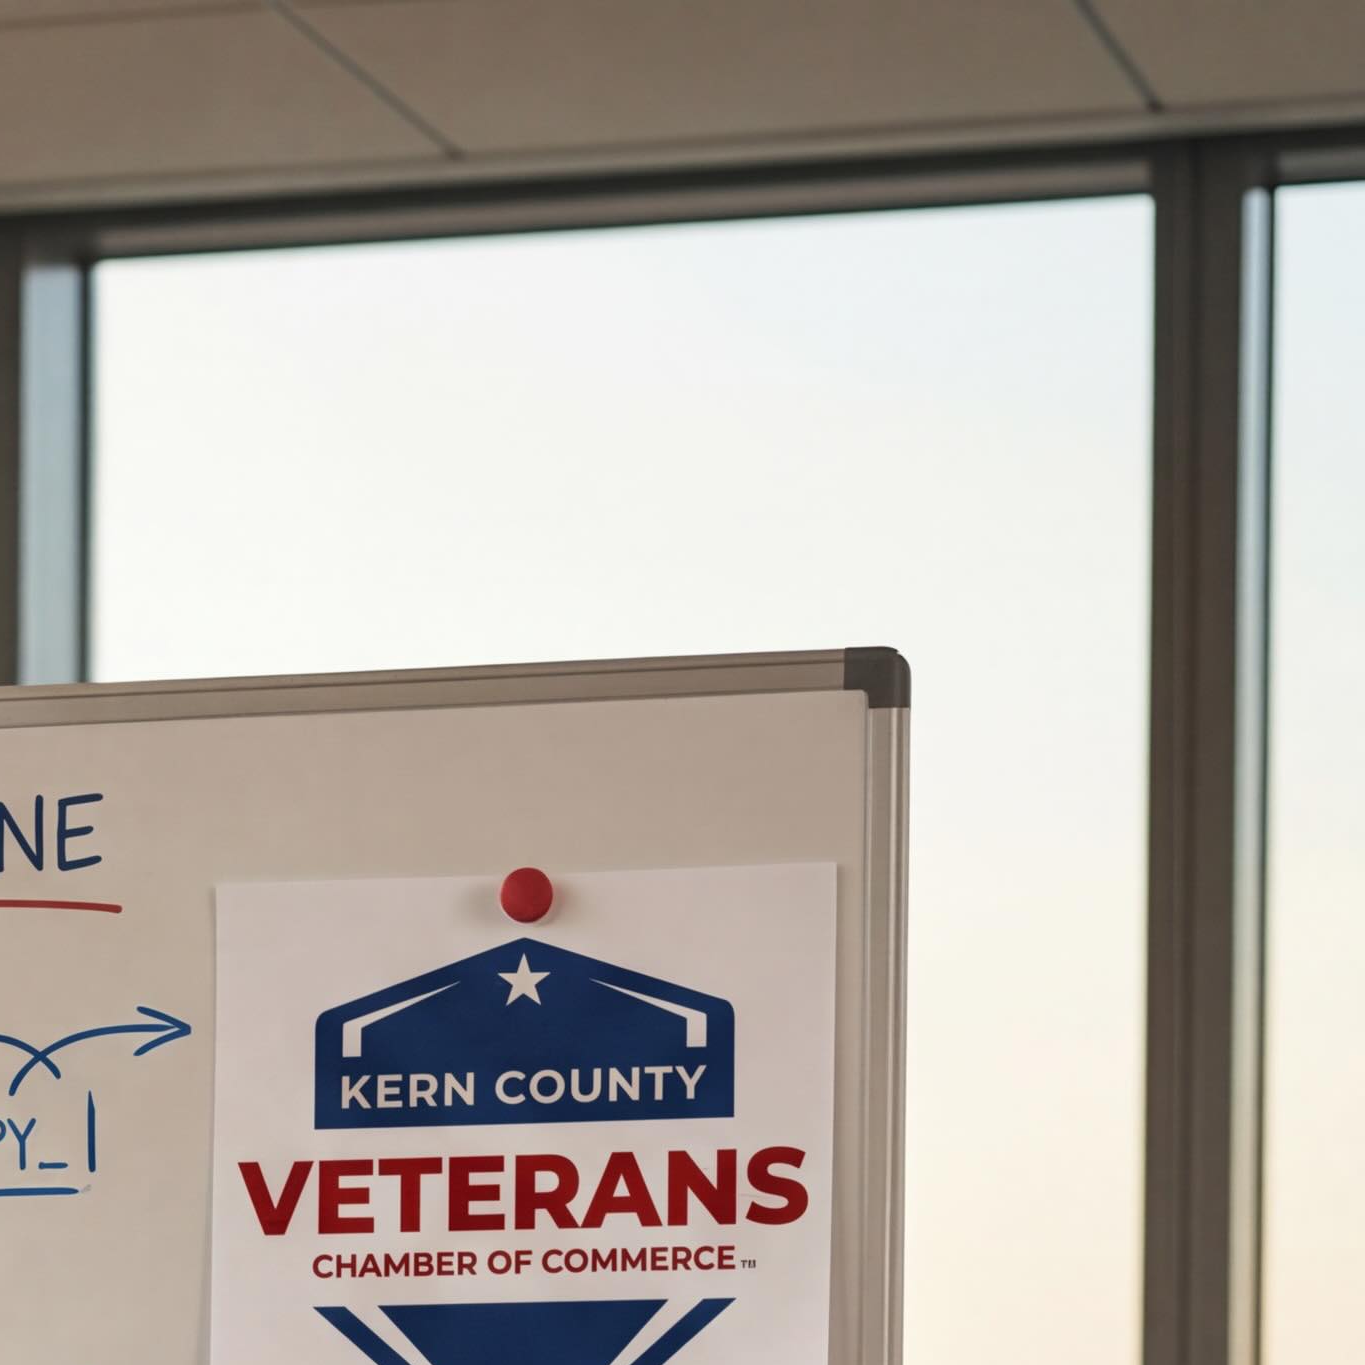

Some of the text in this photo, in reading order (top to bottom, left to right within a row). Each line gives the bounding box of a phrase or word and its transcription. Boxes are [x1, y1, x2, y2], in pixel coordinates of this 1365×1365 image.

[341, 1064, 707, 1109] KERN COUNTY
[237, 1146, 809, 1236] VETERANS
[312, 1251, 478, 1279] CHAMBER
[487, 1249, 533, 1275] OF
[541, 1245, 736, 1274] COMMERCE
